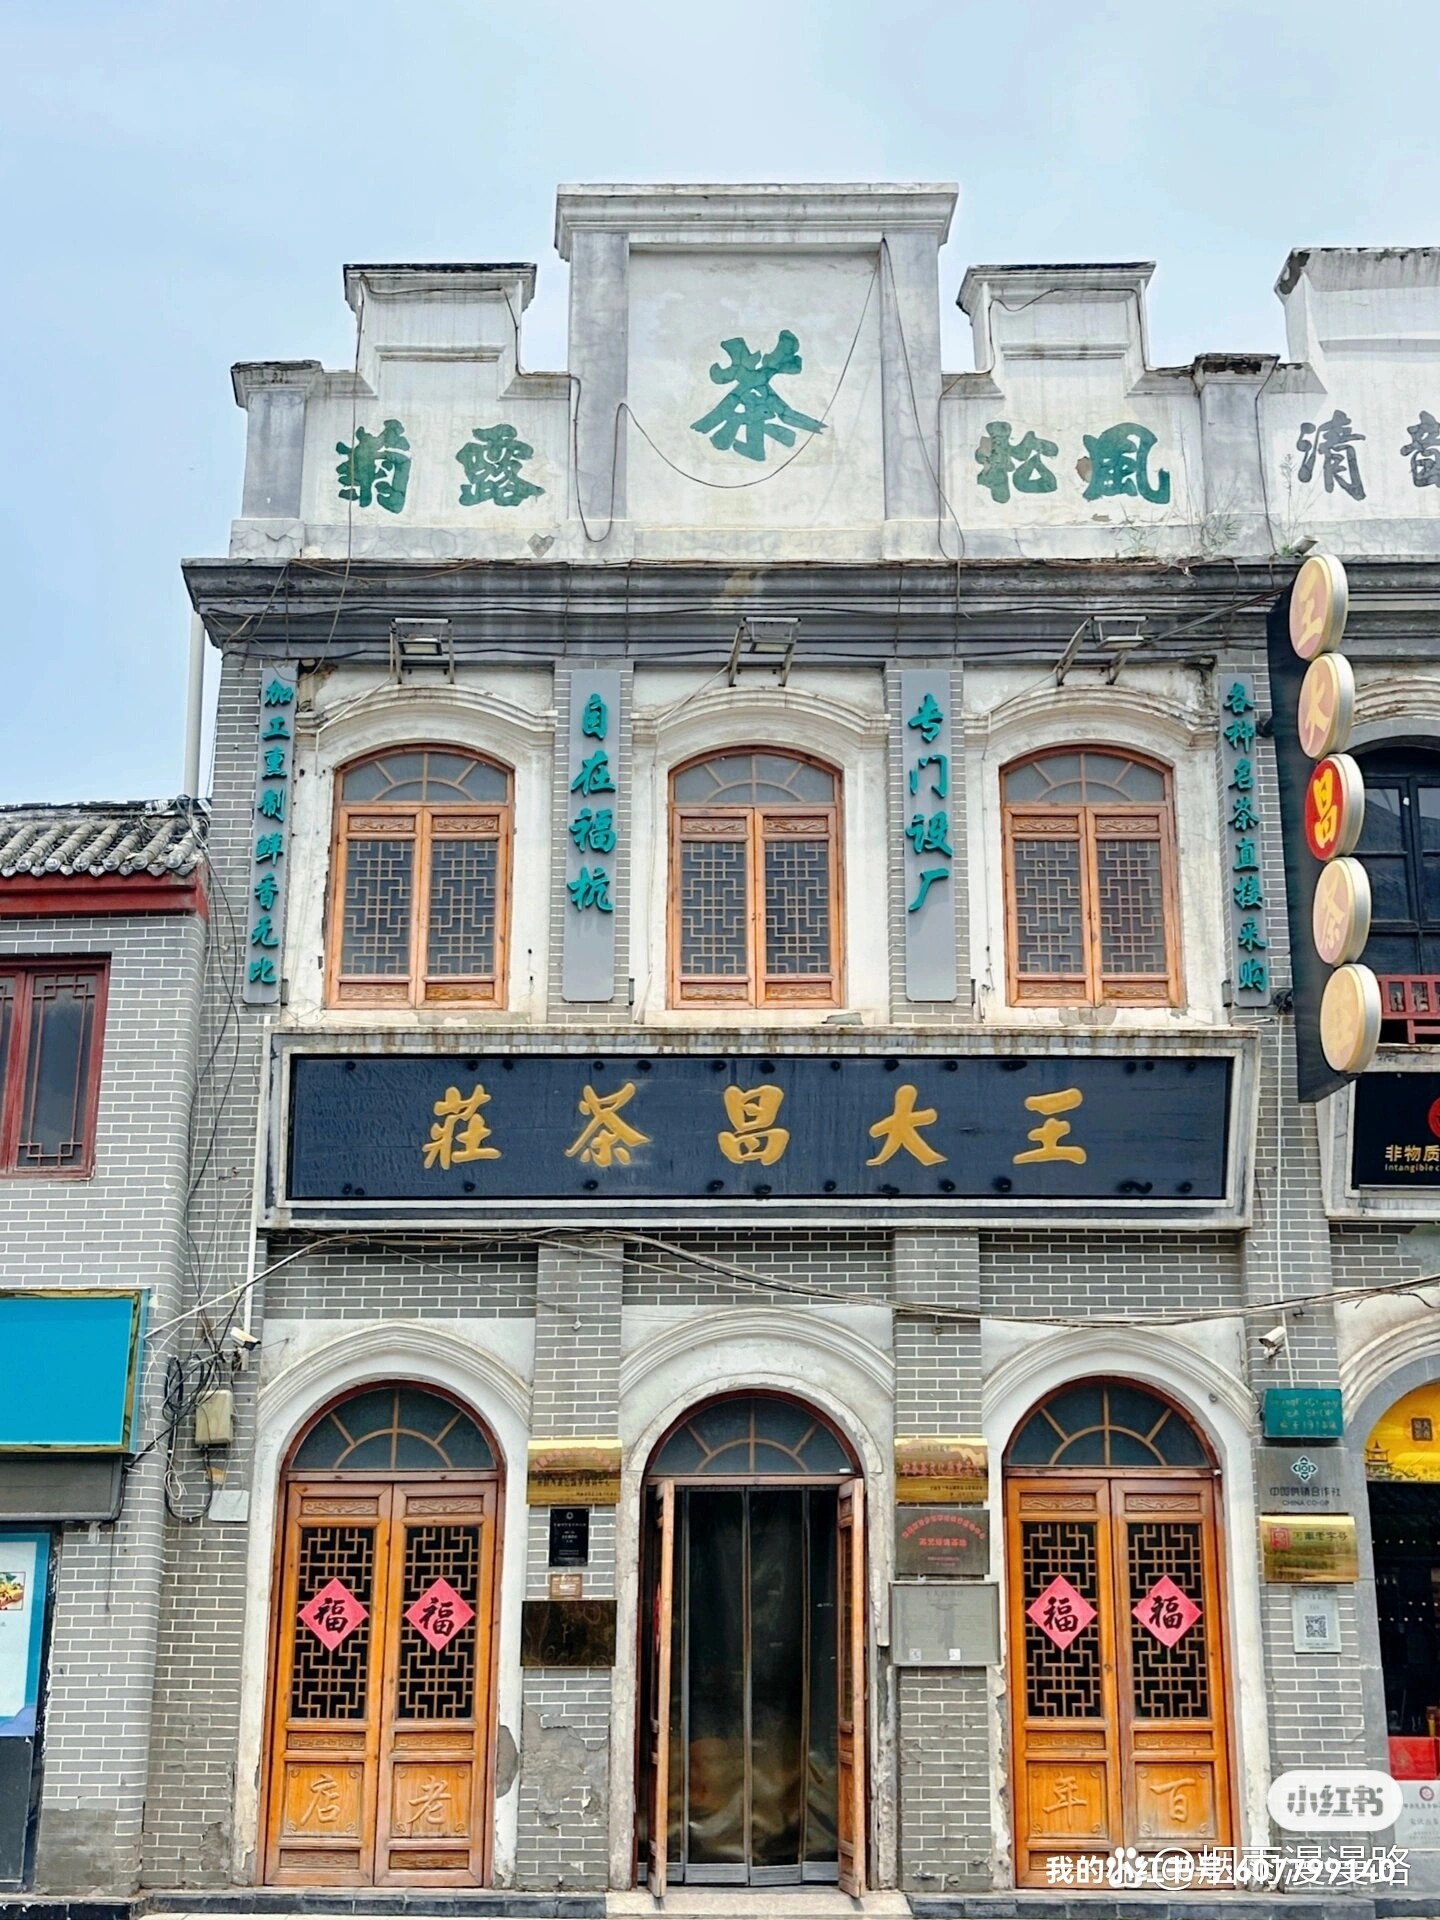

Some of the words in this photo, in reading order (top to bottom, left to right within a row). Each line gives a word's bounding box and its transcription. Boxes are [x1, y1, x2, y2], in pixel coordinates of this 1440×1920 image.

[690, 329, 829, 462] 茶
[566, 693, 617, 914] 自在福杭
[905, 692, 953, 913] 专门设厂
[1385, 1164, 1433, 1174] Intangible
[312, 1597, 349, 1634] 福
[418, 1597, 456, 1637] 福
[1043, 1596, 1080, 1633] 福
[1149, 1595, 1184, 1630] 福
